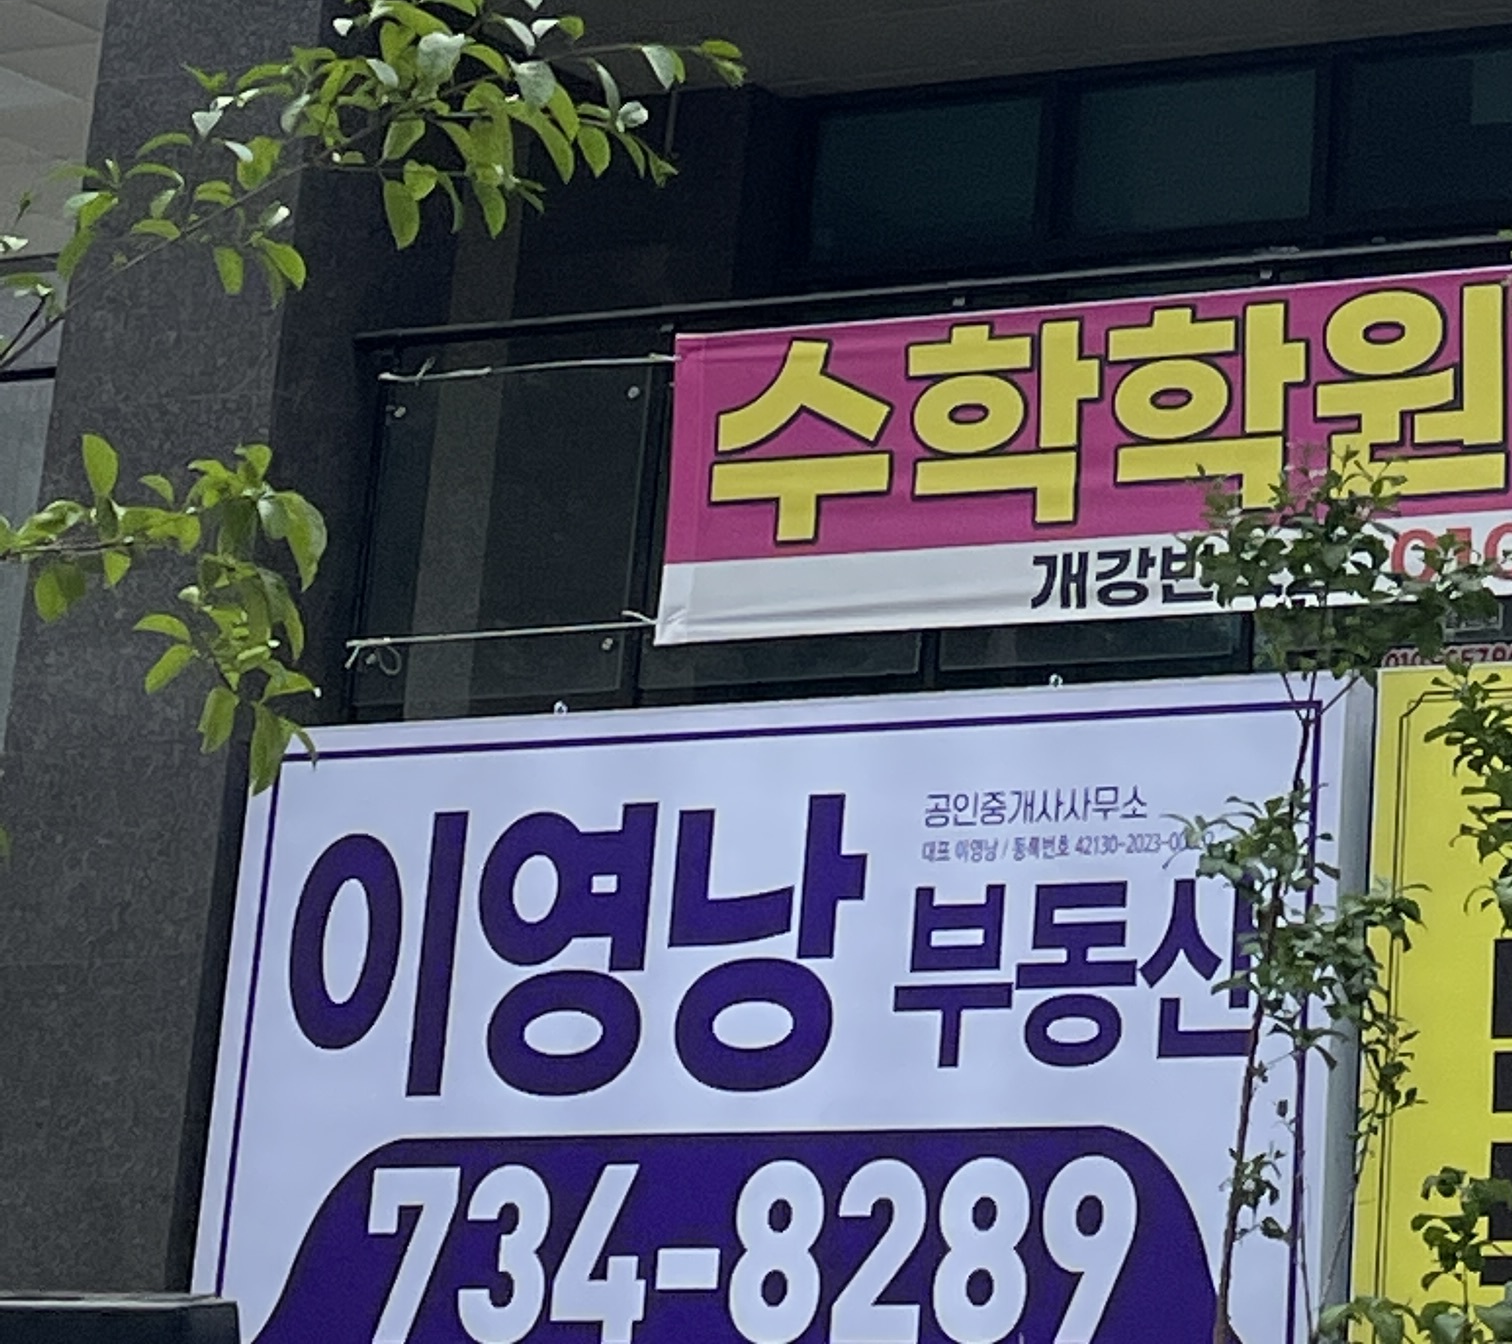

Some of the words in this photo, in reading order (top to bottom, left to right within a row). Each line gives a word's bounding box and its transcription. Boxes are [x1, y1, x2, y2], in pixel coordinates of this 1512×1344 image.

[708, 281, 1510, 547] 수학학원
[924, 784, 1148, 829] 공인중개사사무소
[289, 794, 868, 1098] 이영낭
[893, 878, 1258, 1069] 부동산
[366, 1154, 1139, 1344] 734-8289
